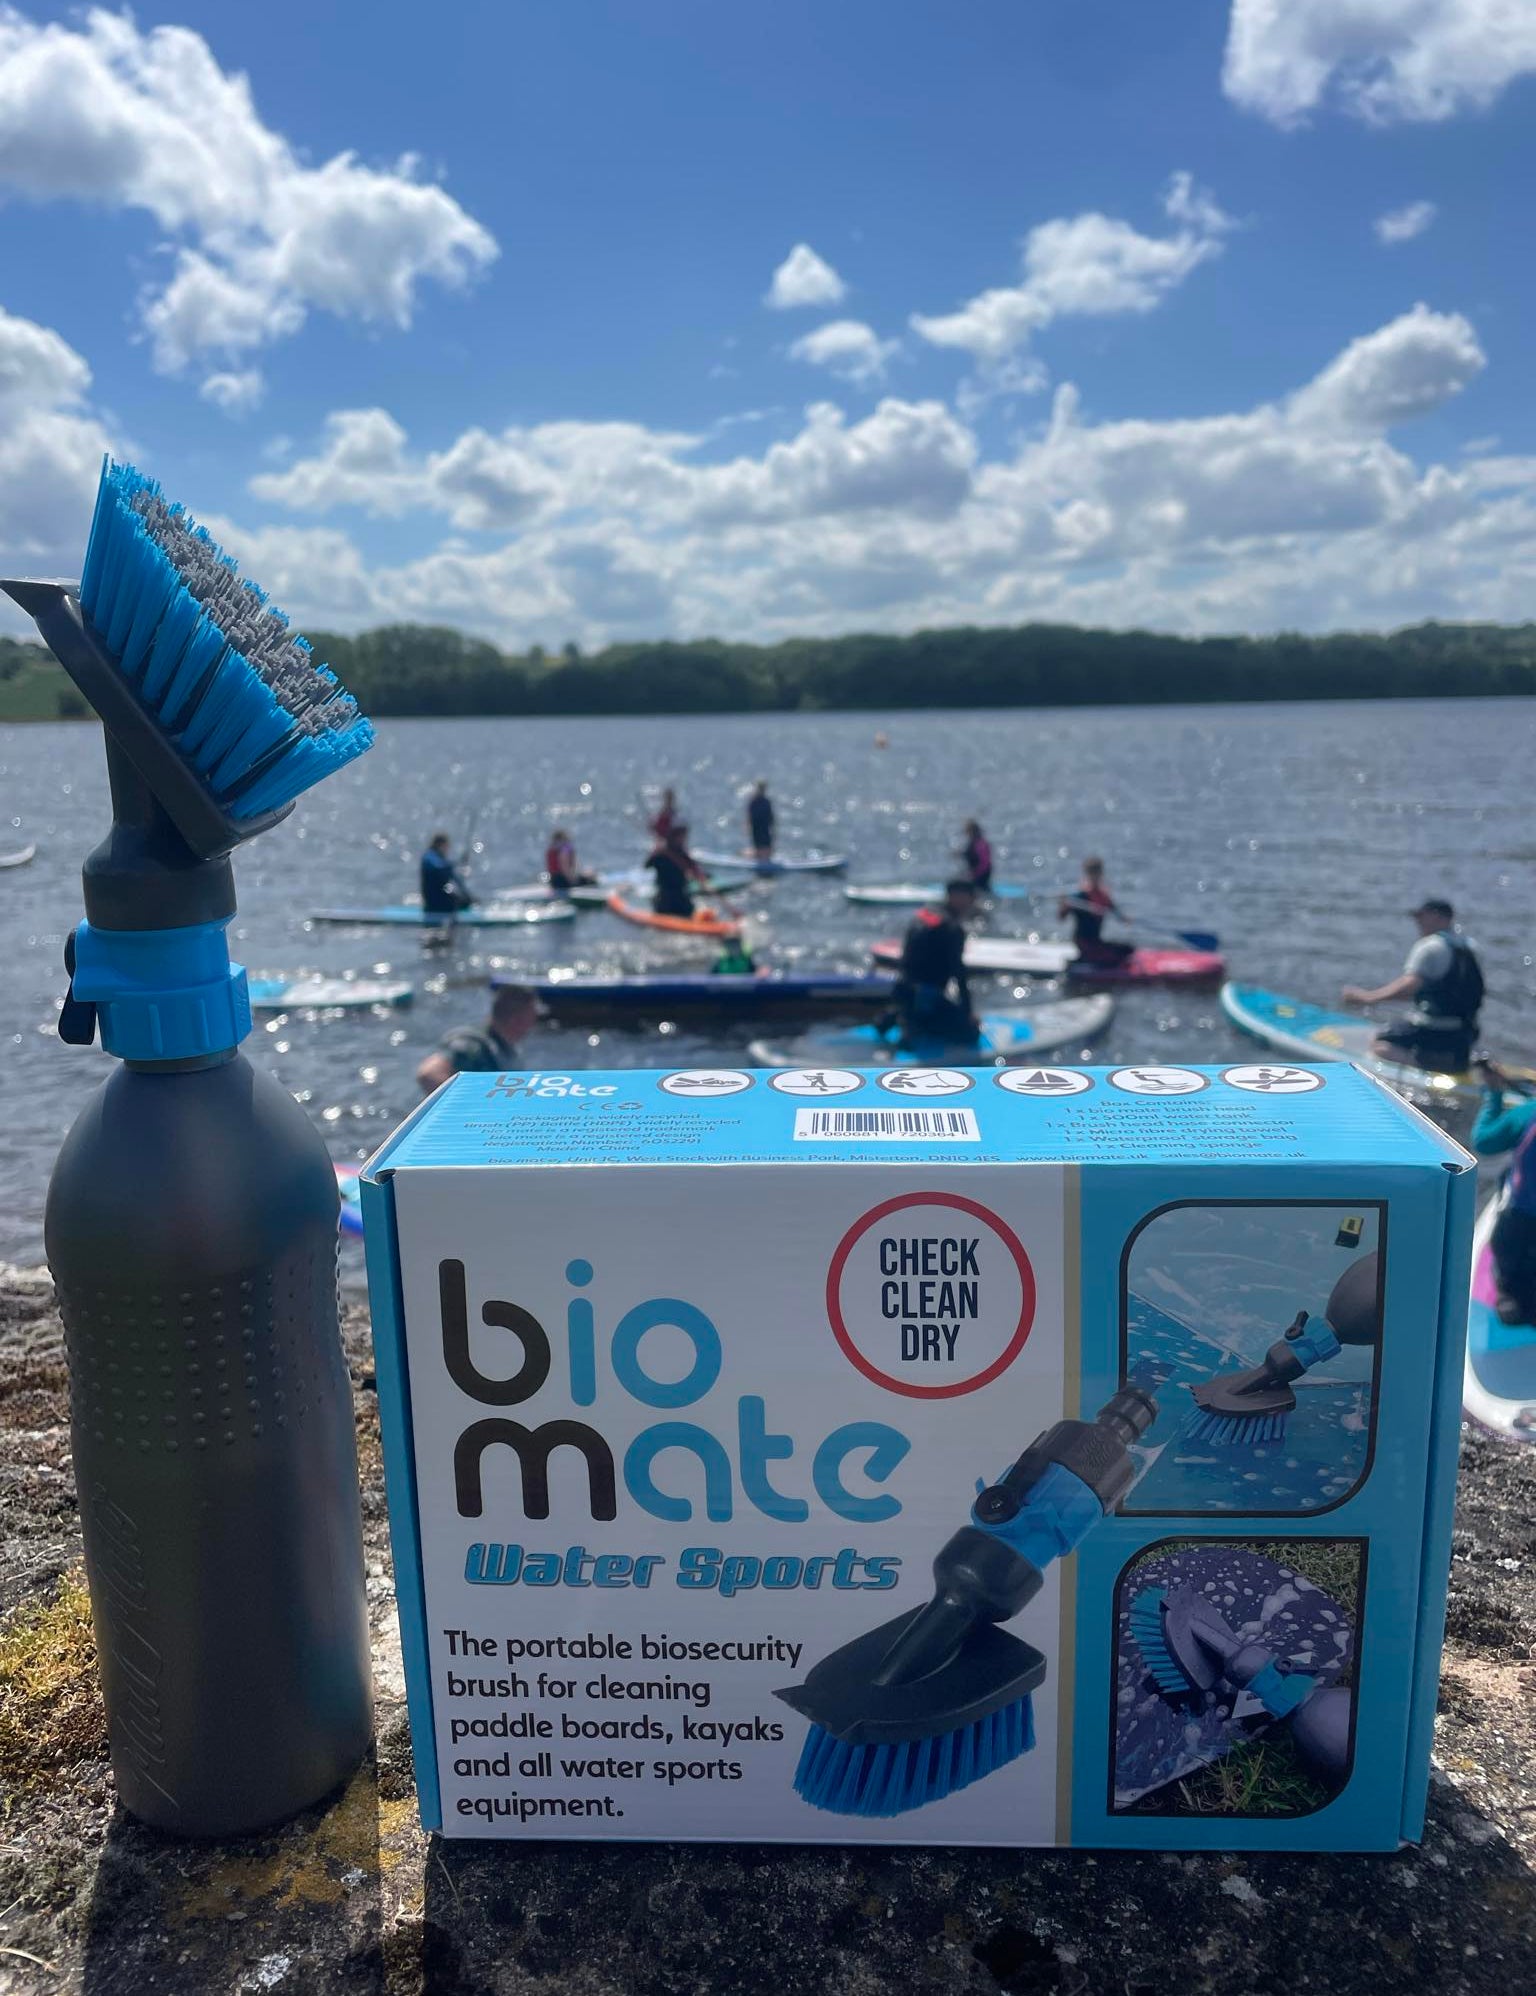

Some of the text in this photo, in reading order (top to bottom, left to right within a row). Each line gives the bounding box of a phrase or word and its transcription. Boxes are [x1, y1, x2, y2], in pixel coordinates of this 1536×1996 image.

[486, 1083, 618, 1098] mate
[495, 1074, 572, 1087] bio
[879, 1238, 981, 1277] CHECK
[881, 1281, 979, 1319] CLEAN
[439, 1258, 722, 1409] bio
[901, 1324, 960, 1362] DRY
[454, 1395, 911, 1523] mate
[464, 1543, 903, 1598] Water Sports
[443, 1630, 803, 1668] The portable biosecurity
[448, 1672, 711, 1708] brush for cleaning
[450, 1713, 785, 1748] paddle boards, kayaks
[454, 1753, 743, 1785] and all water sports
[456, 1794, 625, 1823] equipment.
